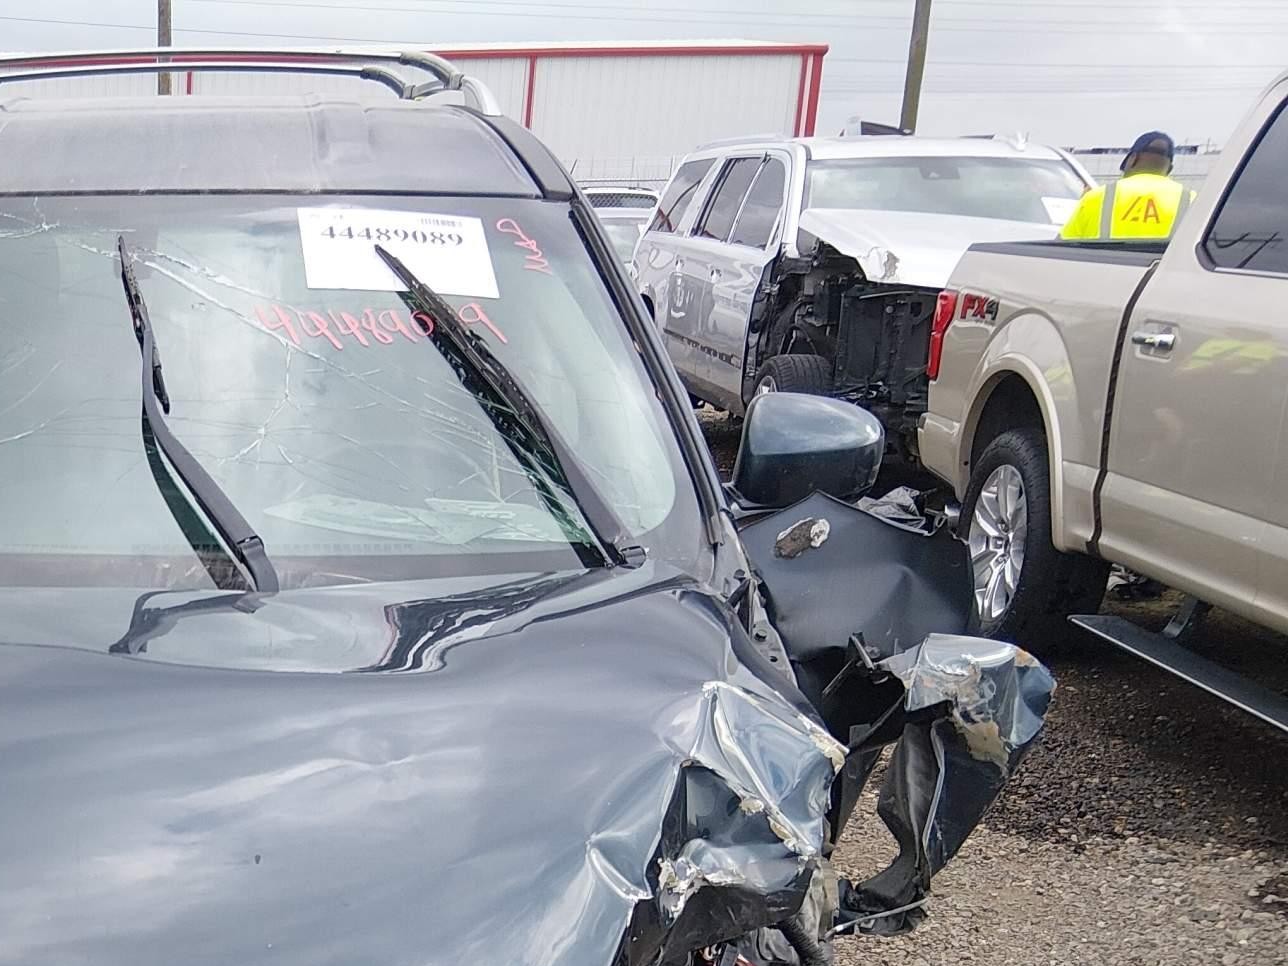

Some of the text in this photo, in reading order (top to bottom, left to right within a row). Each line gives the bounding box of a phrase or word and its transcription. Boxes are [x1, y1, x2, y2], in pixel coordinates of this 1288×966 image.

[320, 225, 463, 246] 44489089
[960, 293, 1000, 321] FX4
[253, 303, 508, 350] 4448909
